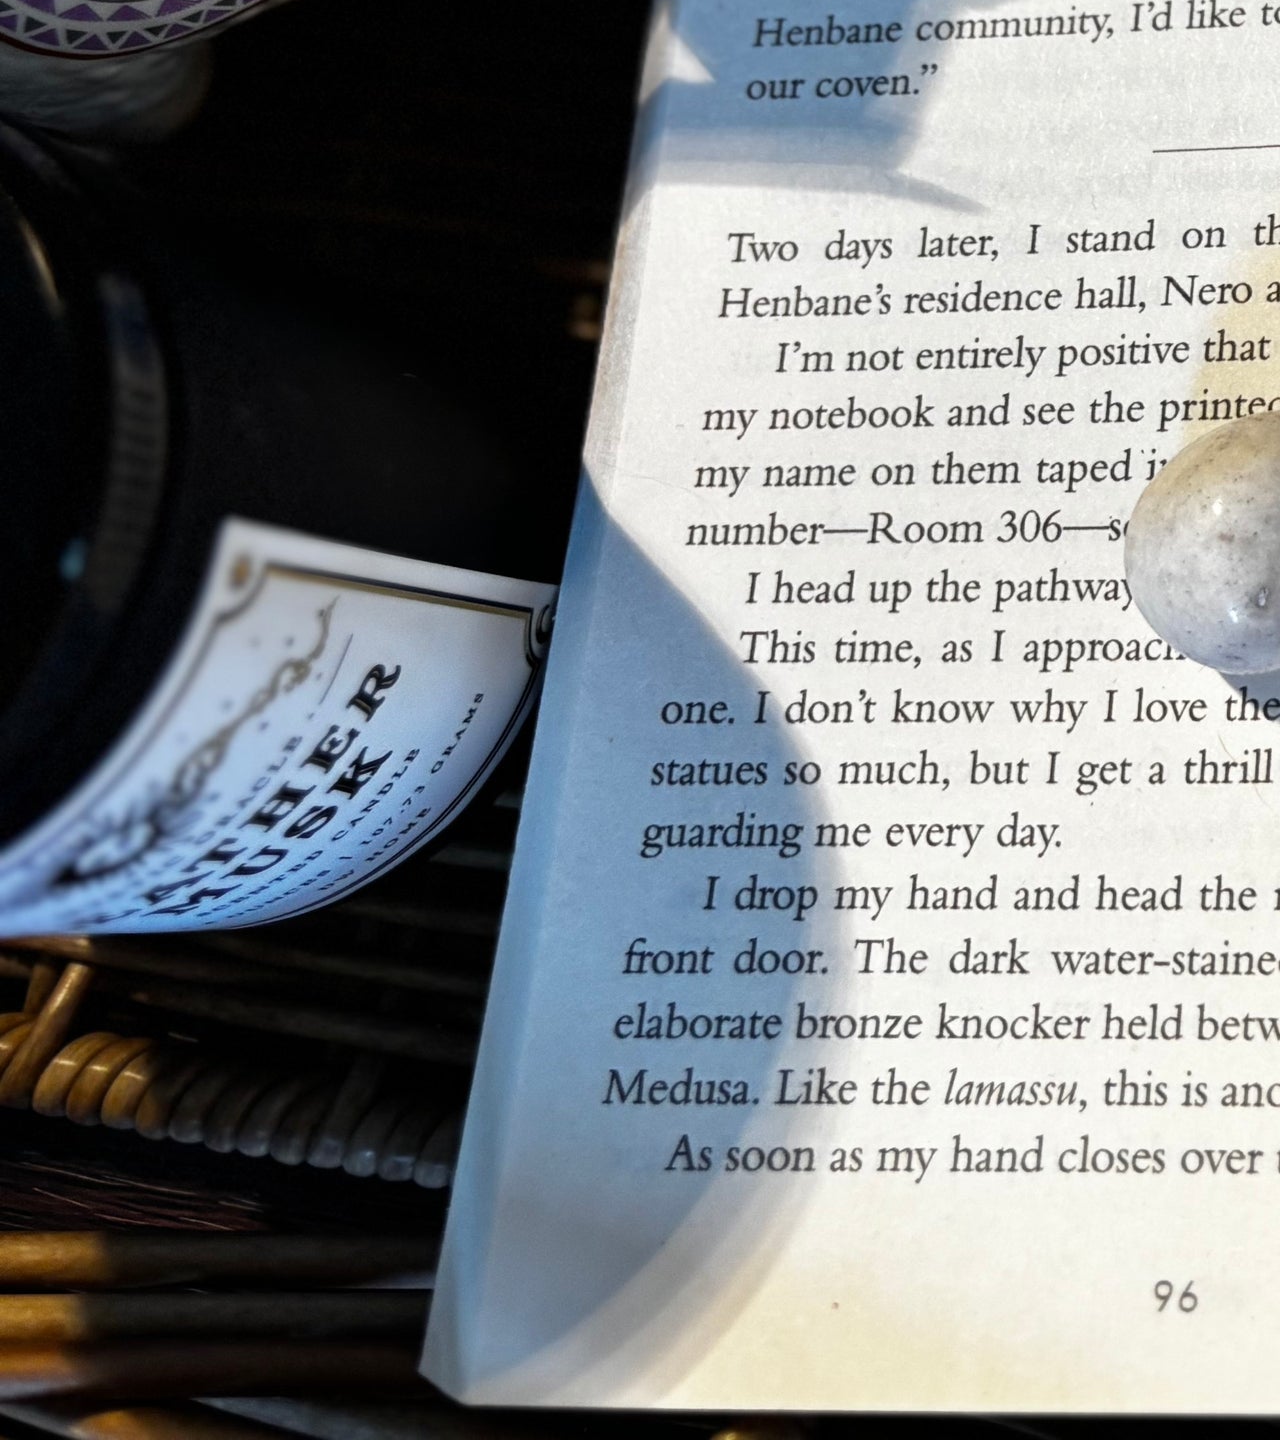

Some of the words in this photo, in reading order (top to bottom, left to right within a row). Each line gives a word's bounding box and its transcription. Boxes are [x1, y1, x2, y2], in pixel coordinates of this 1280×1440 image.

[744, 77, 807, 102] our
[813, 62, 939, 100] coven.”
[716, 281, 893, 320] Henbane’s
[902, 278, 1064, 316] residence
[1073, 273, 1147, 315] hall,
[1159, 273, 1254, 308] Nero
[84, 663, 402, 926] ATHER
[361, 786, 425, 845] 107.73
[431, 693, 484, 774] GRAMS
[649, 757, 770, 788] statues
[782, 760, 823, 787] so
[836, 747, 951, 793] much,
[969, 748, 1031, 786] but
[1044, 750, 1062, 786] I
[1074, 756, 1134, 797] get
[1146, 760, 1167, 786] a
[1182, 746, 1275, 786] thrill
[140, 746, 395, 916] MUSK
[196, 850, 324, 917] SCENTED
[332, 748, 420, 841] CANDLE
[365, 807, 431, 861] HOME
[620, 935, 717, 977] front
[731, 935, 830, 976] door.
[852, 935, 930, 976] The
[947, 936, 1031, 976] dark
[600, 1065, 761, 1108] Medusa.
[772, 1065, 859, 1107] Like
[870, 1066, 932, 1107] the
[943, 1066, 1089, 1114] lamassu,
[1102, 1067, 1169, 1108] this
[1179, 1069, 1209, 1109] is
[662, 1132, 714, 1174] As
[723, 1145, 817, 1174] soon
[828, 1146, 864, 1174] as
[875, 1146, 939, 1185] my
[948, 1132, 1045, 1174] hand
[1056, 1133, 1167, 1175] closes
[1179, 1147, 1265, 1176] over
[1153, 1279, 1199, 1314] 96
